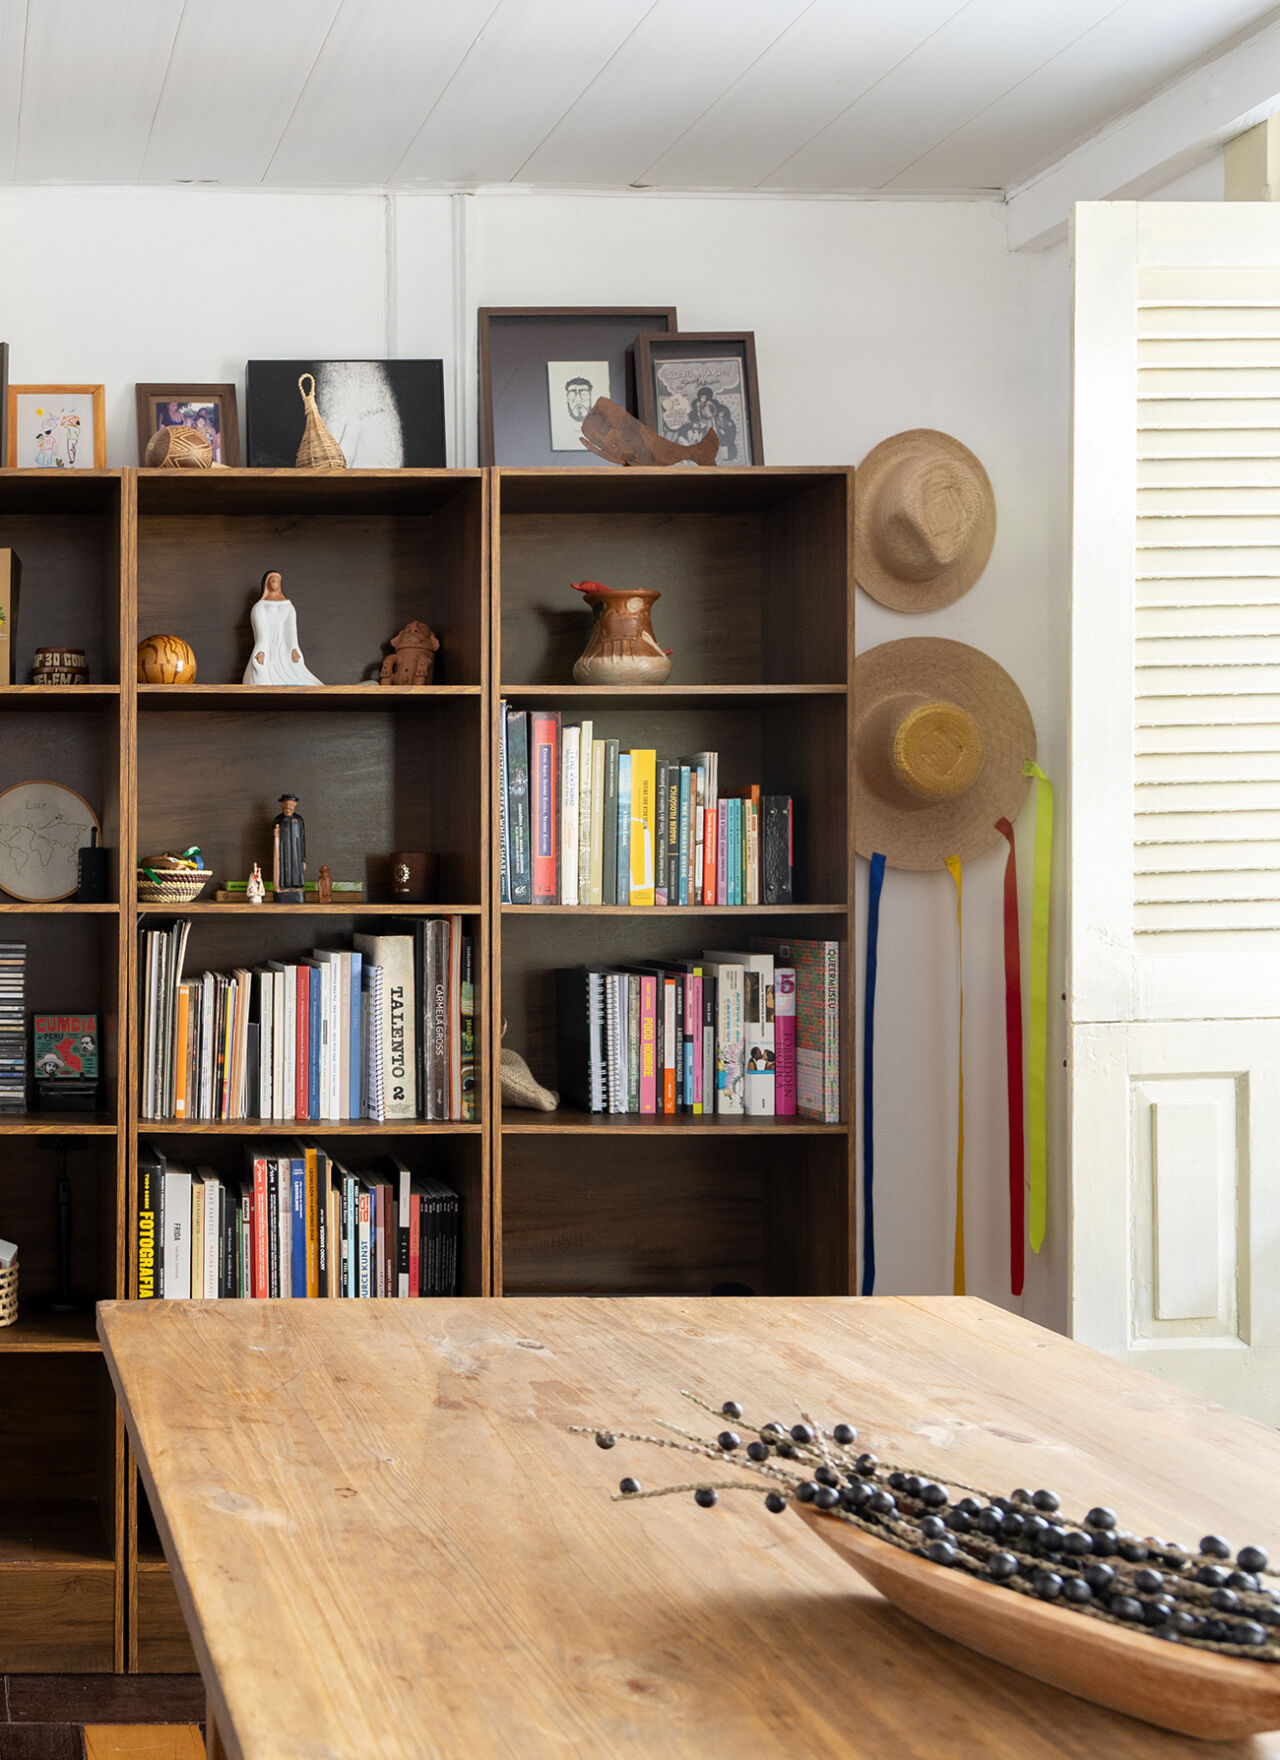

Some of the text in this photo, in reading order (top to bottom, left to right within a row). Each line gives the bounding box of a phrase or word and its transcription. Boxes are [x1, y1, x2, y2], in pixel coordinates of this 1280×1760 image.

[670, 785, 678, 844] VIAGEM FILOSÓFICA
[828, 950, 836, 1009] QUEERMUSEU
[390, 986, 404, 1100] TALENTO 2
[435, 984, 444, 1056] CARMELA GROSS
[644, 1017, 653, 1077] POCO HOMBRE
[784, 1032, 793, 1097] FORBIDDEN
[139, 1211, 154, 1298] FOTOGRAFIA
[173, 1223, 181, 1241] FRIDA
